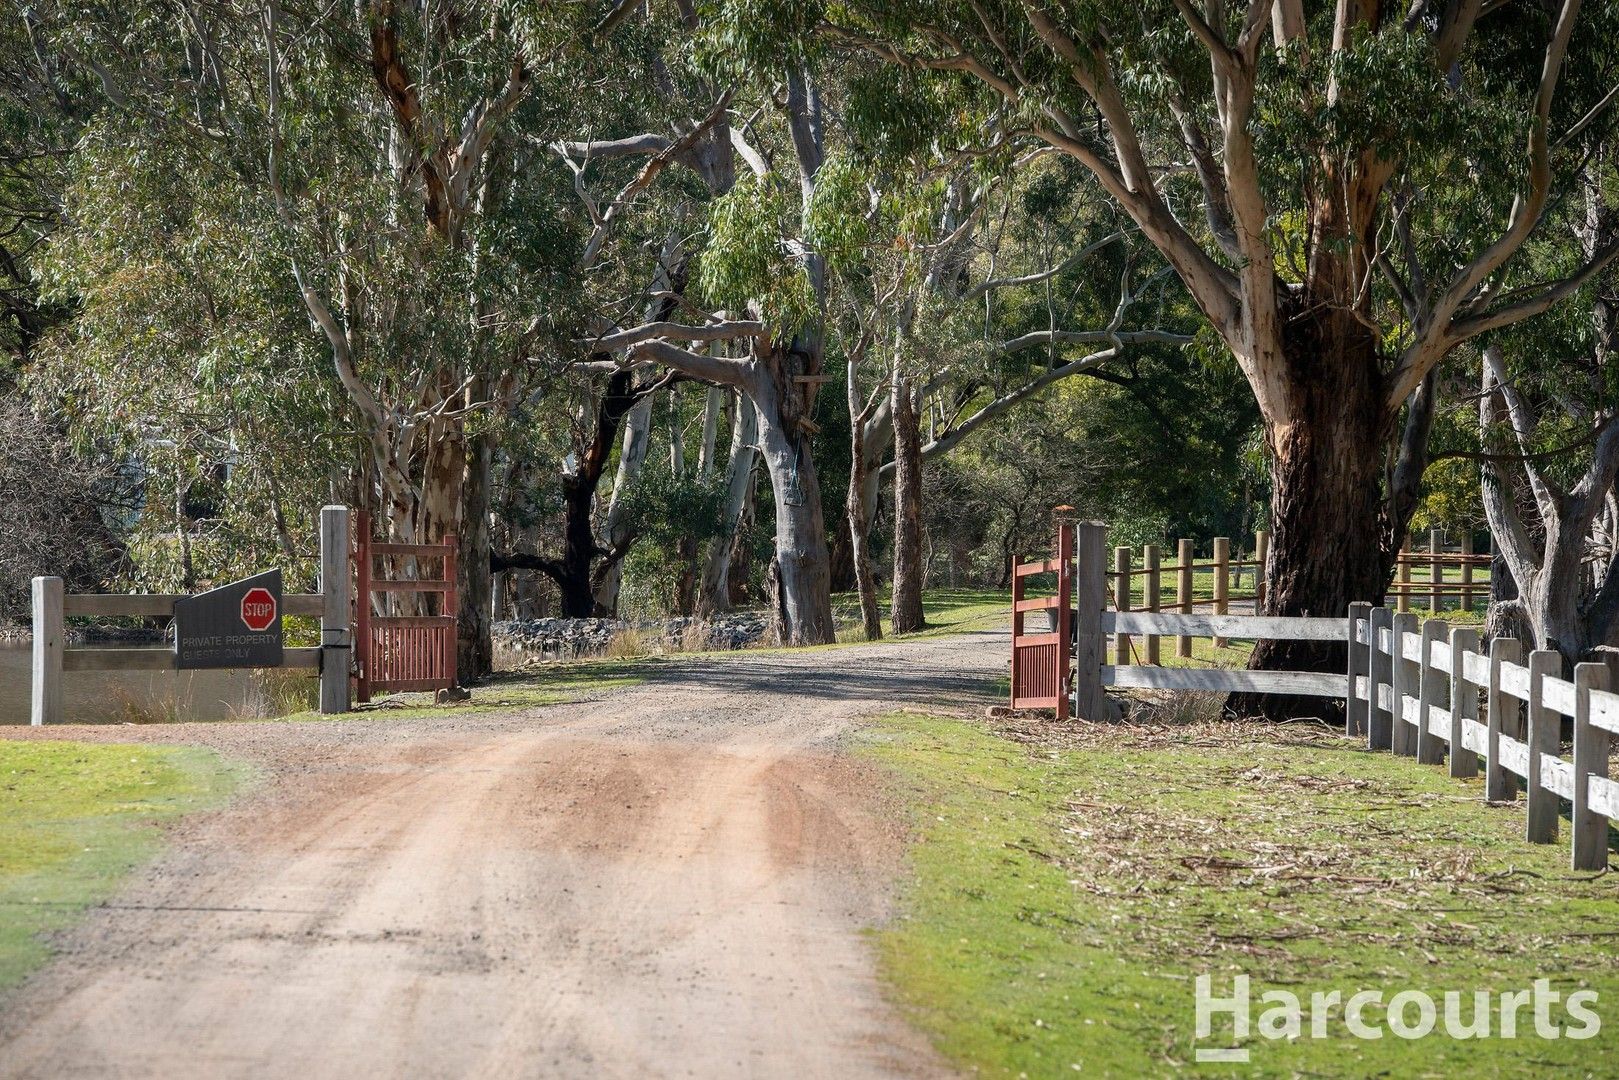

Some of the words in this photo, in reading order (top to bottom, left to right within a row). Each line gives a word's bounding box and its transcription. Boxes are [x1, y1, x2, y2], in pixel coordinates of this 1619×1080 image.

[245, 602, 272, 617] STOP
[182, 636, 222, 648] PRIVATE
[225, 634, 278, 645] PROPERTY
[182, 649, 220, 660] GUESTS
[224, 647, 251, 659] ONLY
